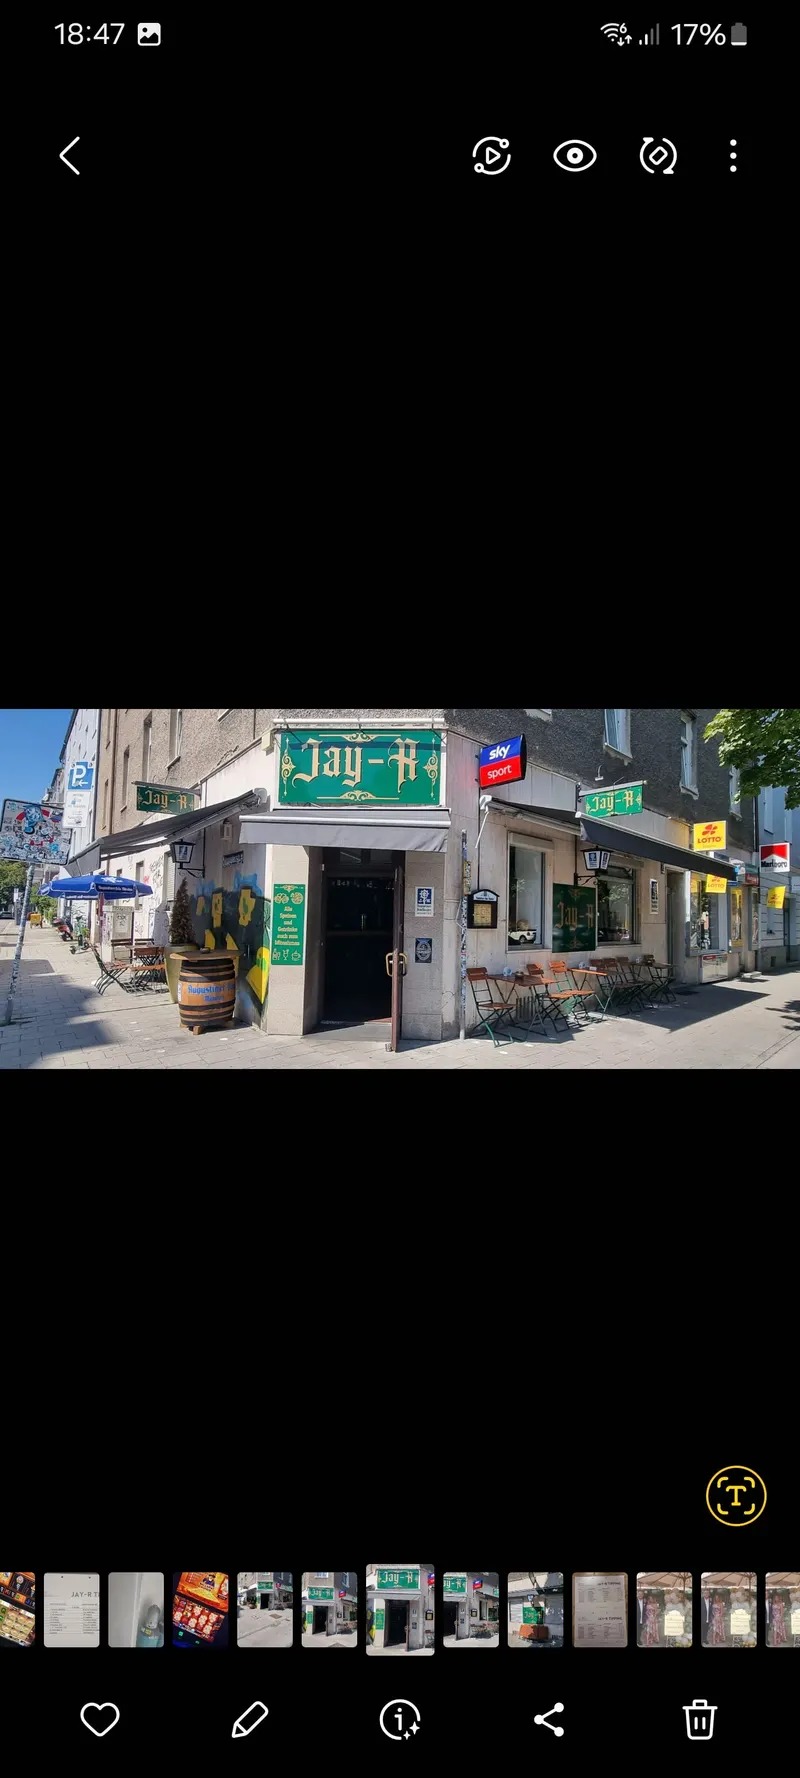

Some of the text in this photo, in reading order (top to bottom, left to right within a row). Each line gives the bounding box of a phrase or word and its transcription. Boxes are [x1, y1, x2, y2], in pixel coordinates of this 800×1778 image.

[489, 744, 511, 760] sky
[291, 737, 420, 793] Jay-R
[487, 764, 512, 781] sport
[72, 765, 87, 787] P
[142, 789, 187, 813] Jay-R
[590, 790, 635, 812] Jay-R
[697, 836, 721, 844] LOTTO
[760, 859, 788, 869] Marlboro
